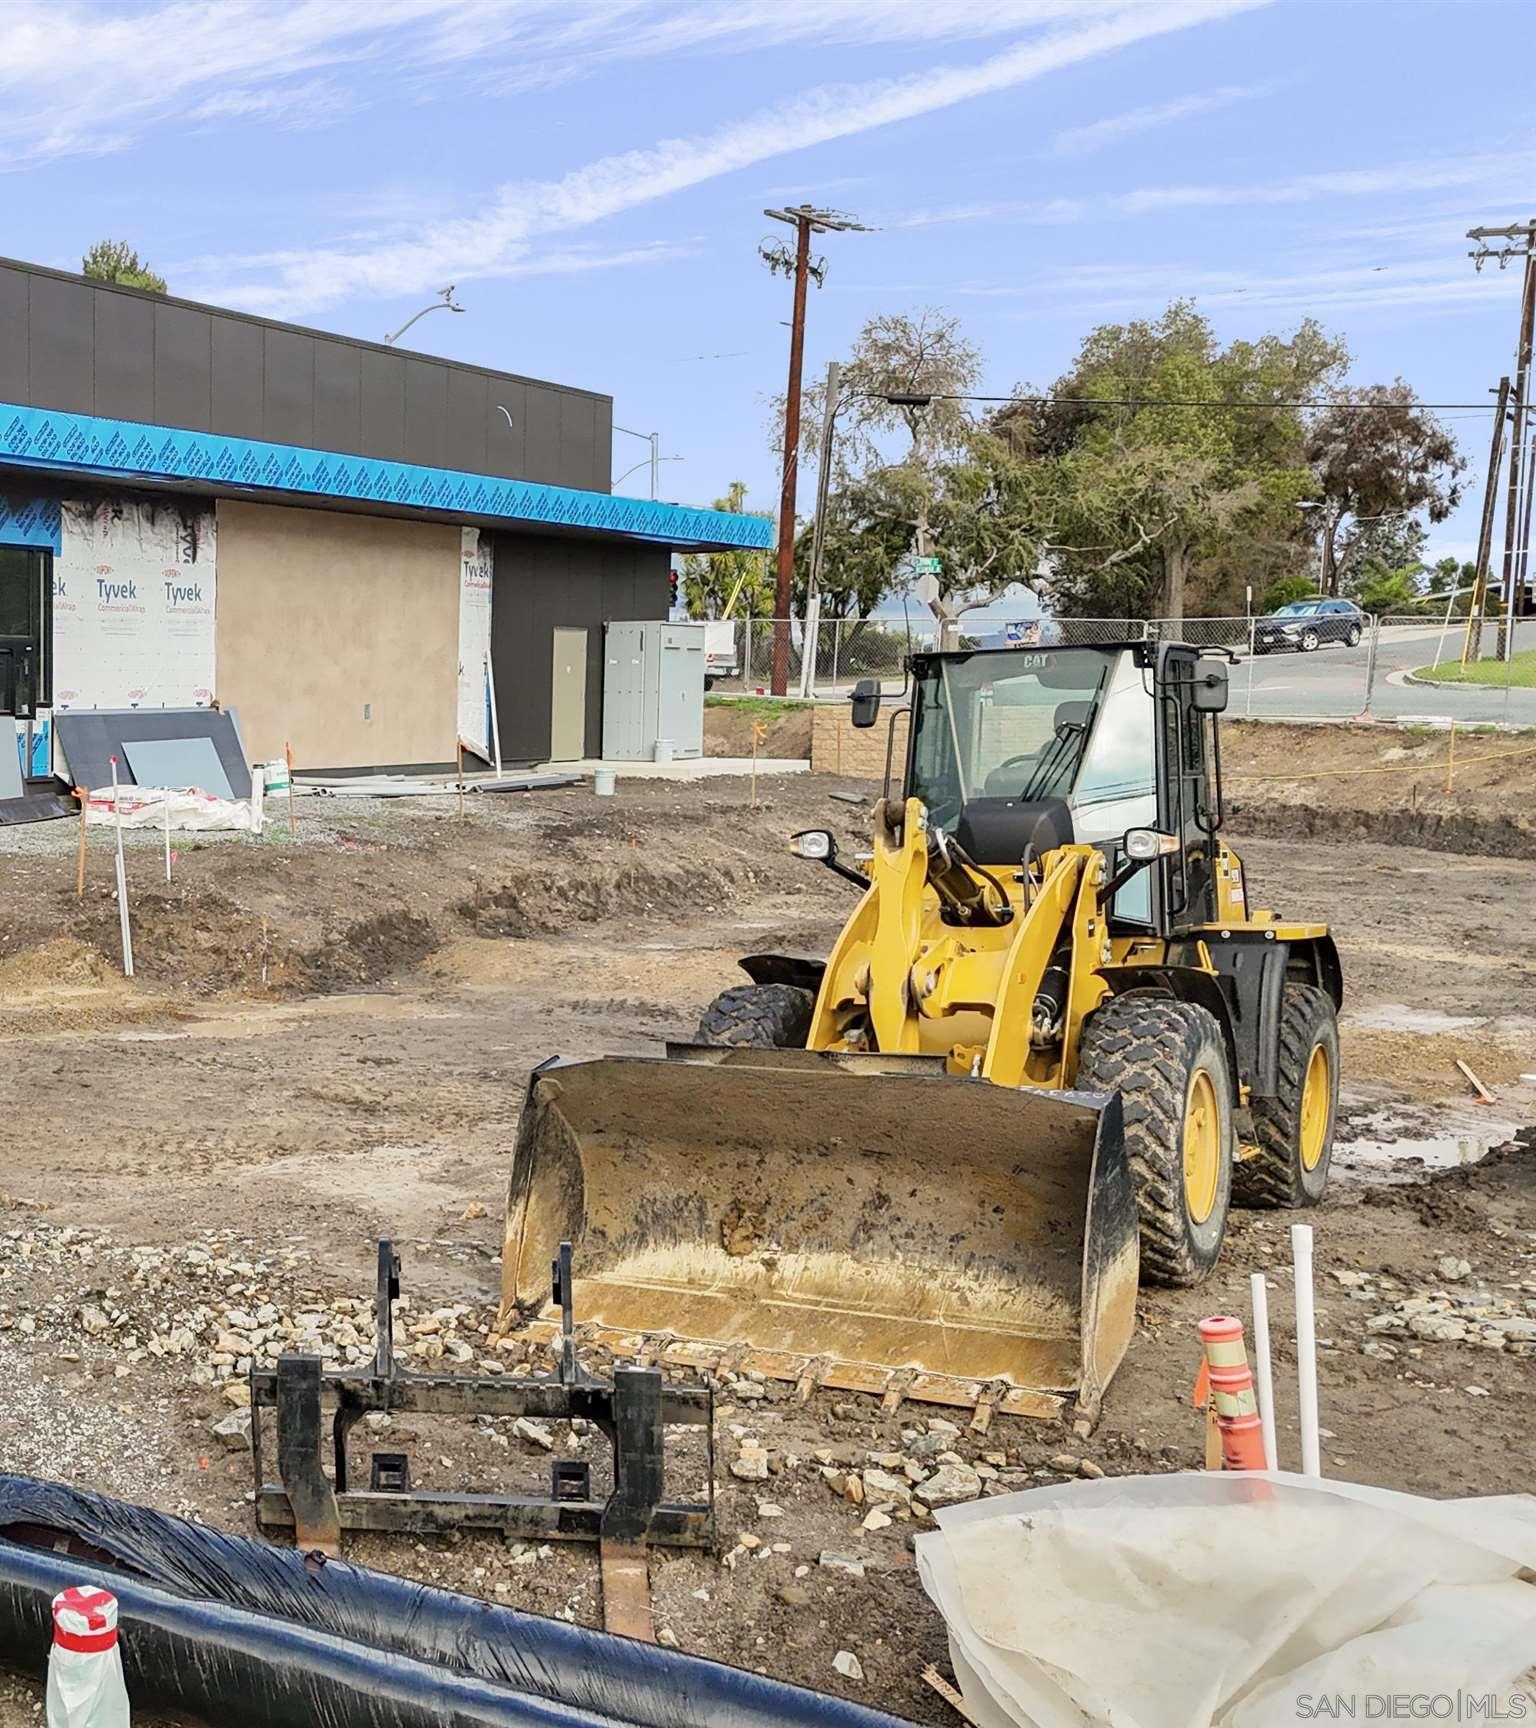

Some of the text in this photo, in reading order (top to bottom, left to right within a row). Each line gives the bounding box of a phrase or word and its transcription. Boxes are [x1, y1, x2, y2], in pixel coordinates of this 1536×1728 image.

[97, 579, 136, 603] Tyvek
[165, 582, 201, 606] Tyvek
[1024, 653, 1048, 668] CAT
